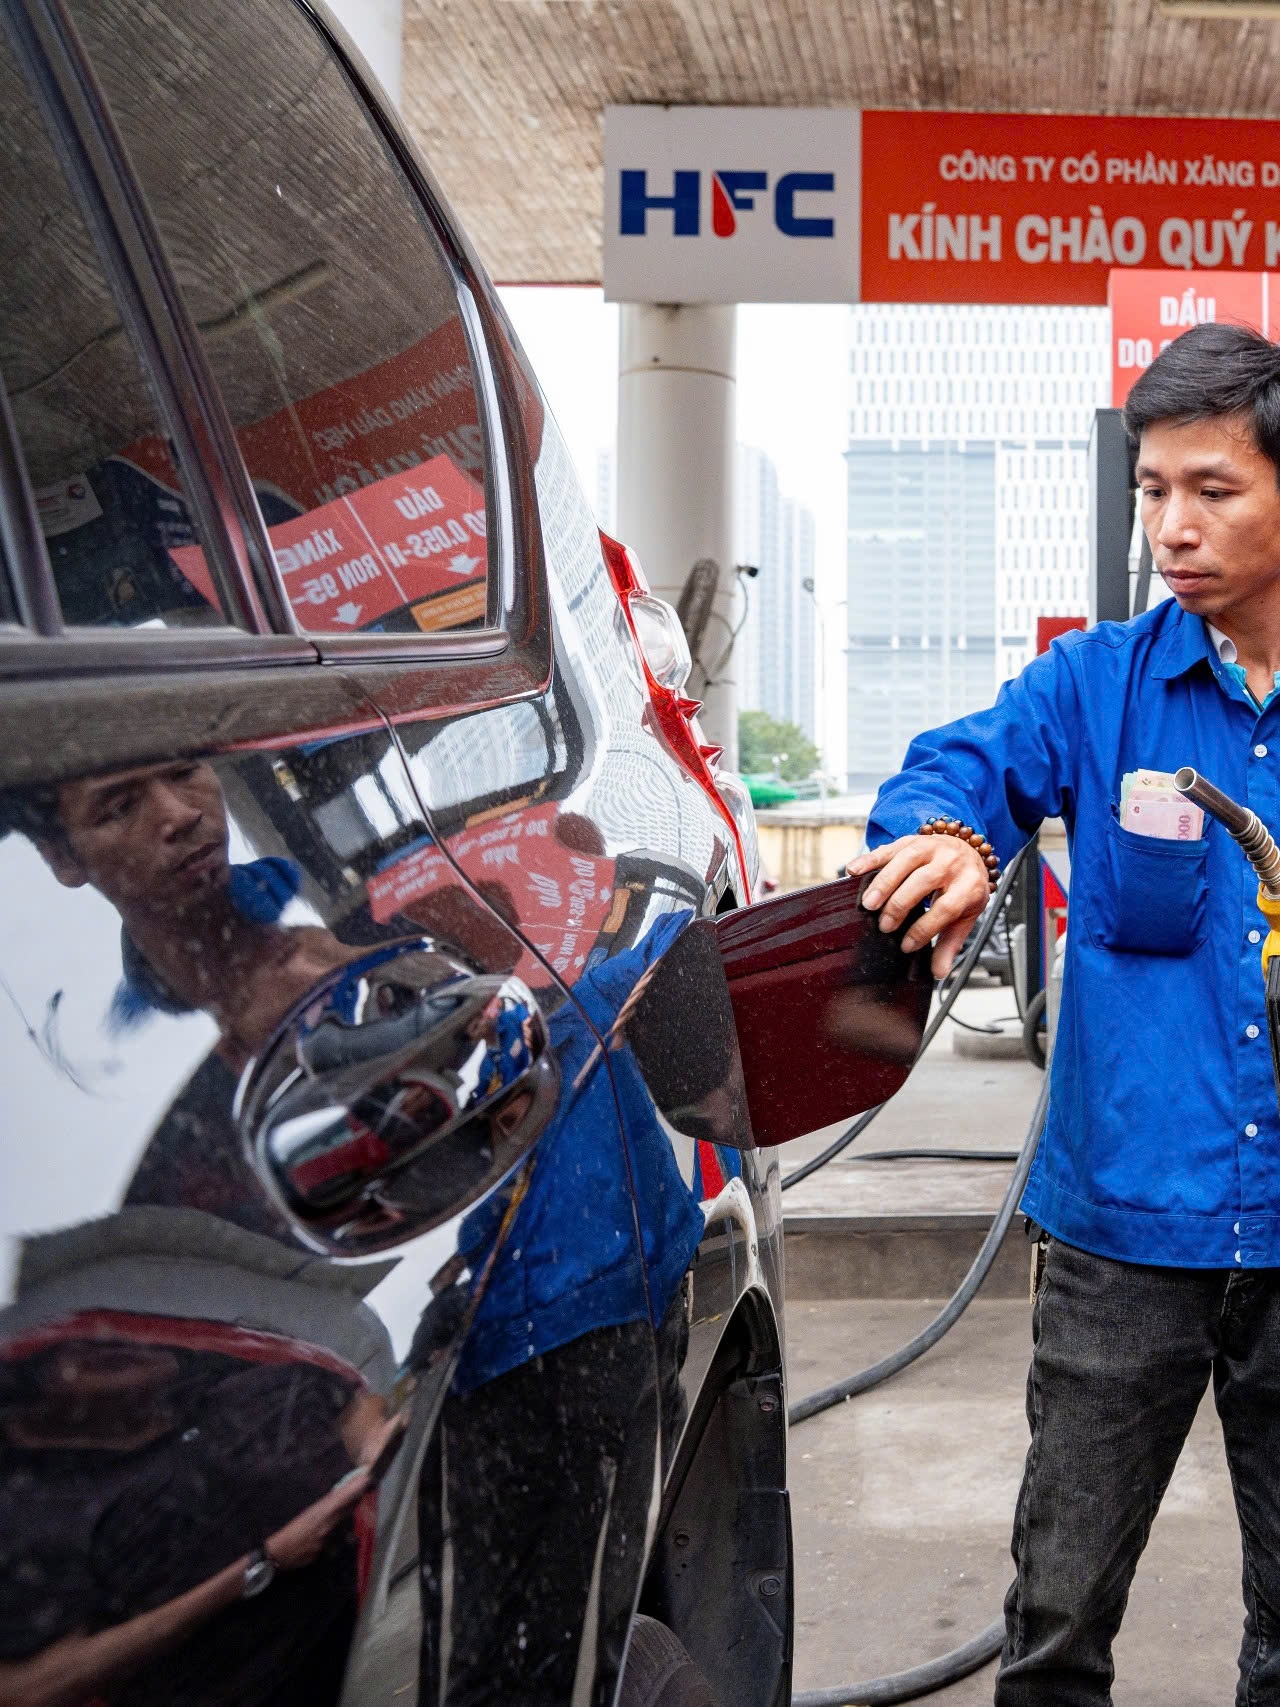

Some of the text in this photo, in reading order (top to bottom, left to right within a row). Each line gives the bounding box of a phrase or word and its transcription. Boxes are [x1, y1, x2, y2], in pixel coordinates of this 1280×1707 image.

[938, 148, 1017, 181] CÔNG
[1022, 155, 1055, 182] TY
[1183, 154, 1255, 187] XĂNG
[620, 170, 836, 239] HFC
[887, 201, 1002, 262] KÍNH
[1014, 204, 1147, 266] CHÀO
[1158, 208, 1255, 270] QUÝ
[1118, 338, 1153, 369] DO
